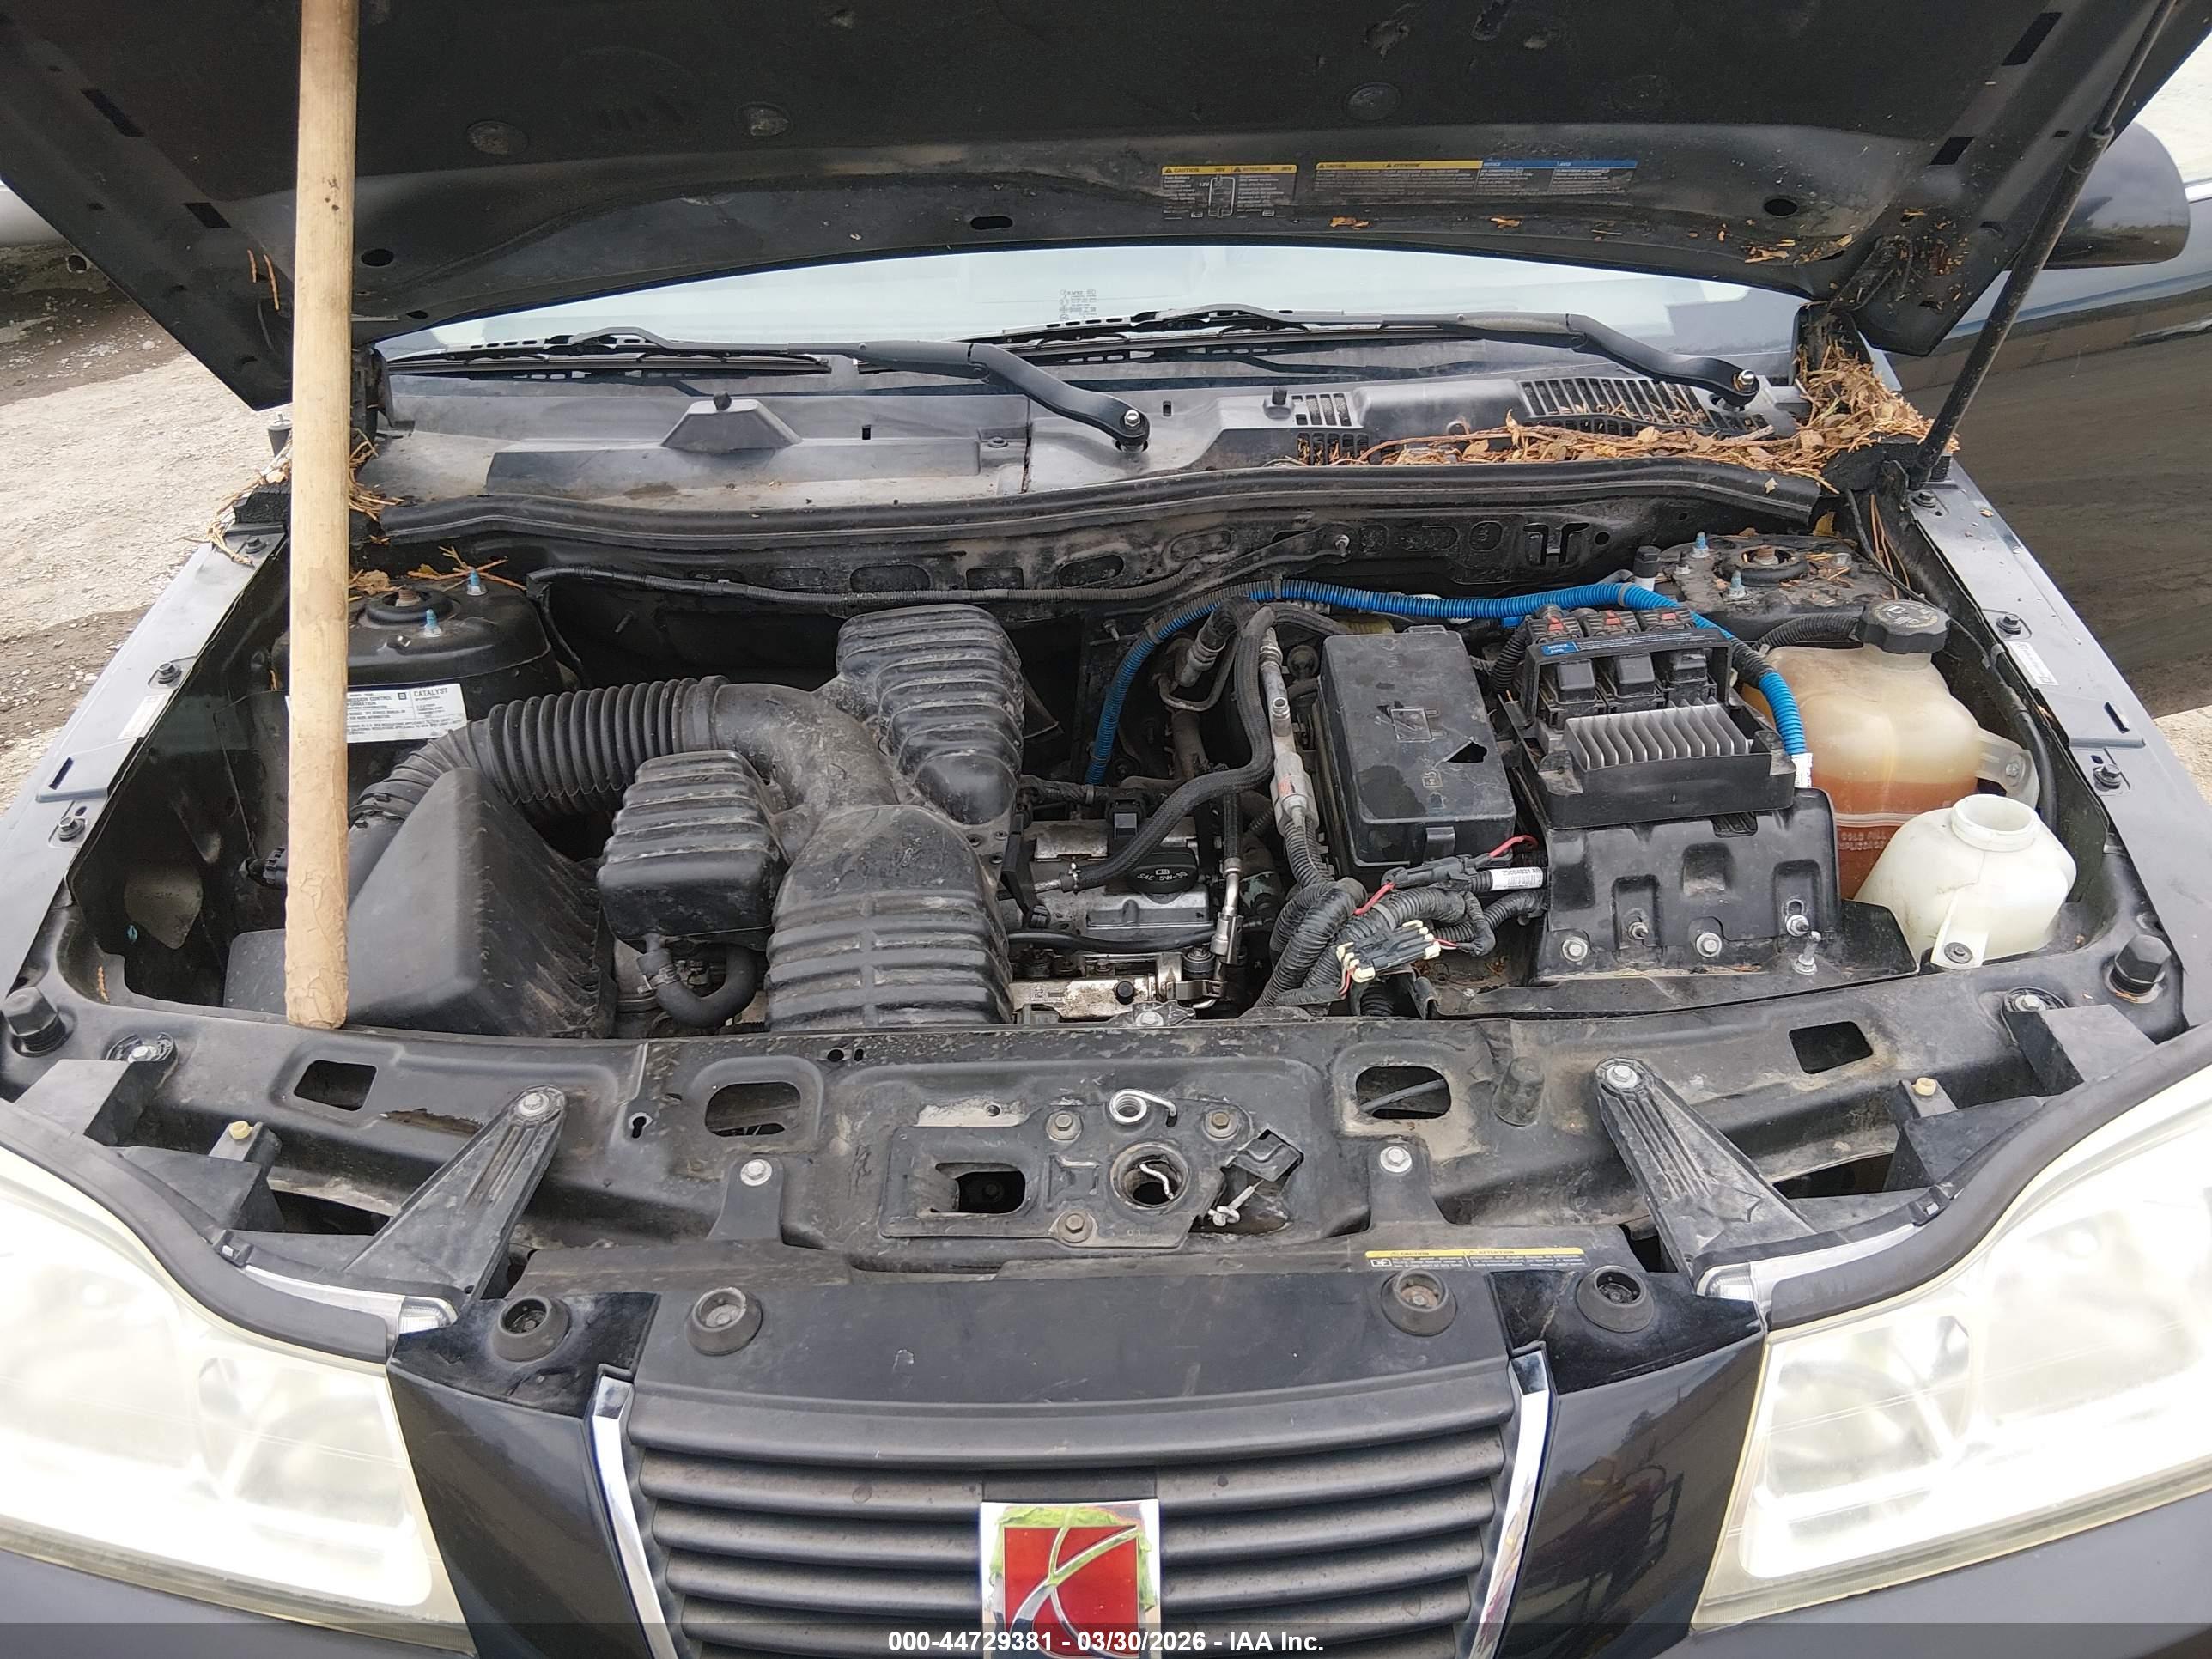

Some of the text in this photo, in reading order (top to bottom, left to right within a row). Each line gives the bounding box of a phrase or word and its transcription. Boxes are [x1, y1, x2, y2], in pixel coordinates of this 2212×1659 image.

[413, 687, 447, 697] CATALYST
[1137, 872, 1188, 881] SAE 5W-30
